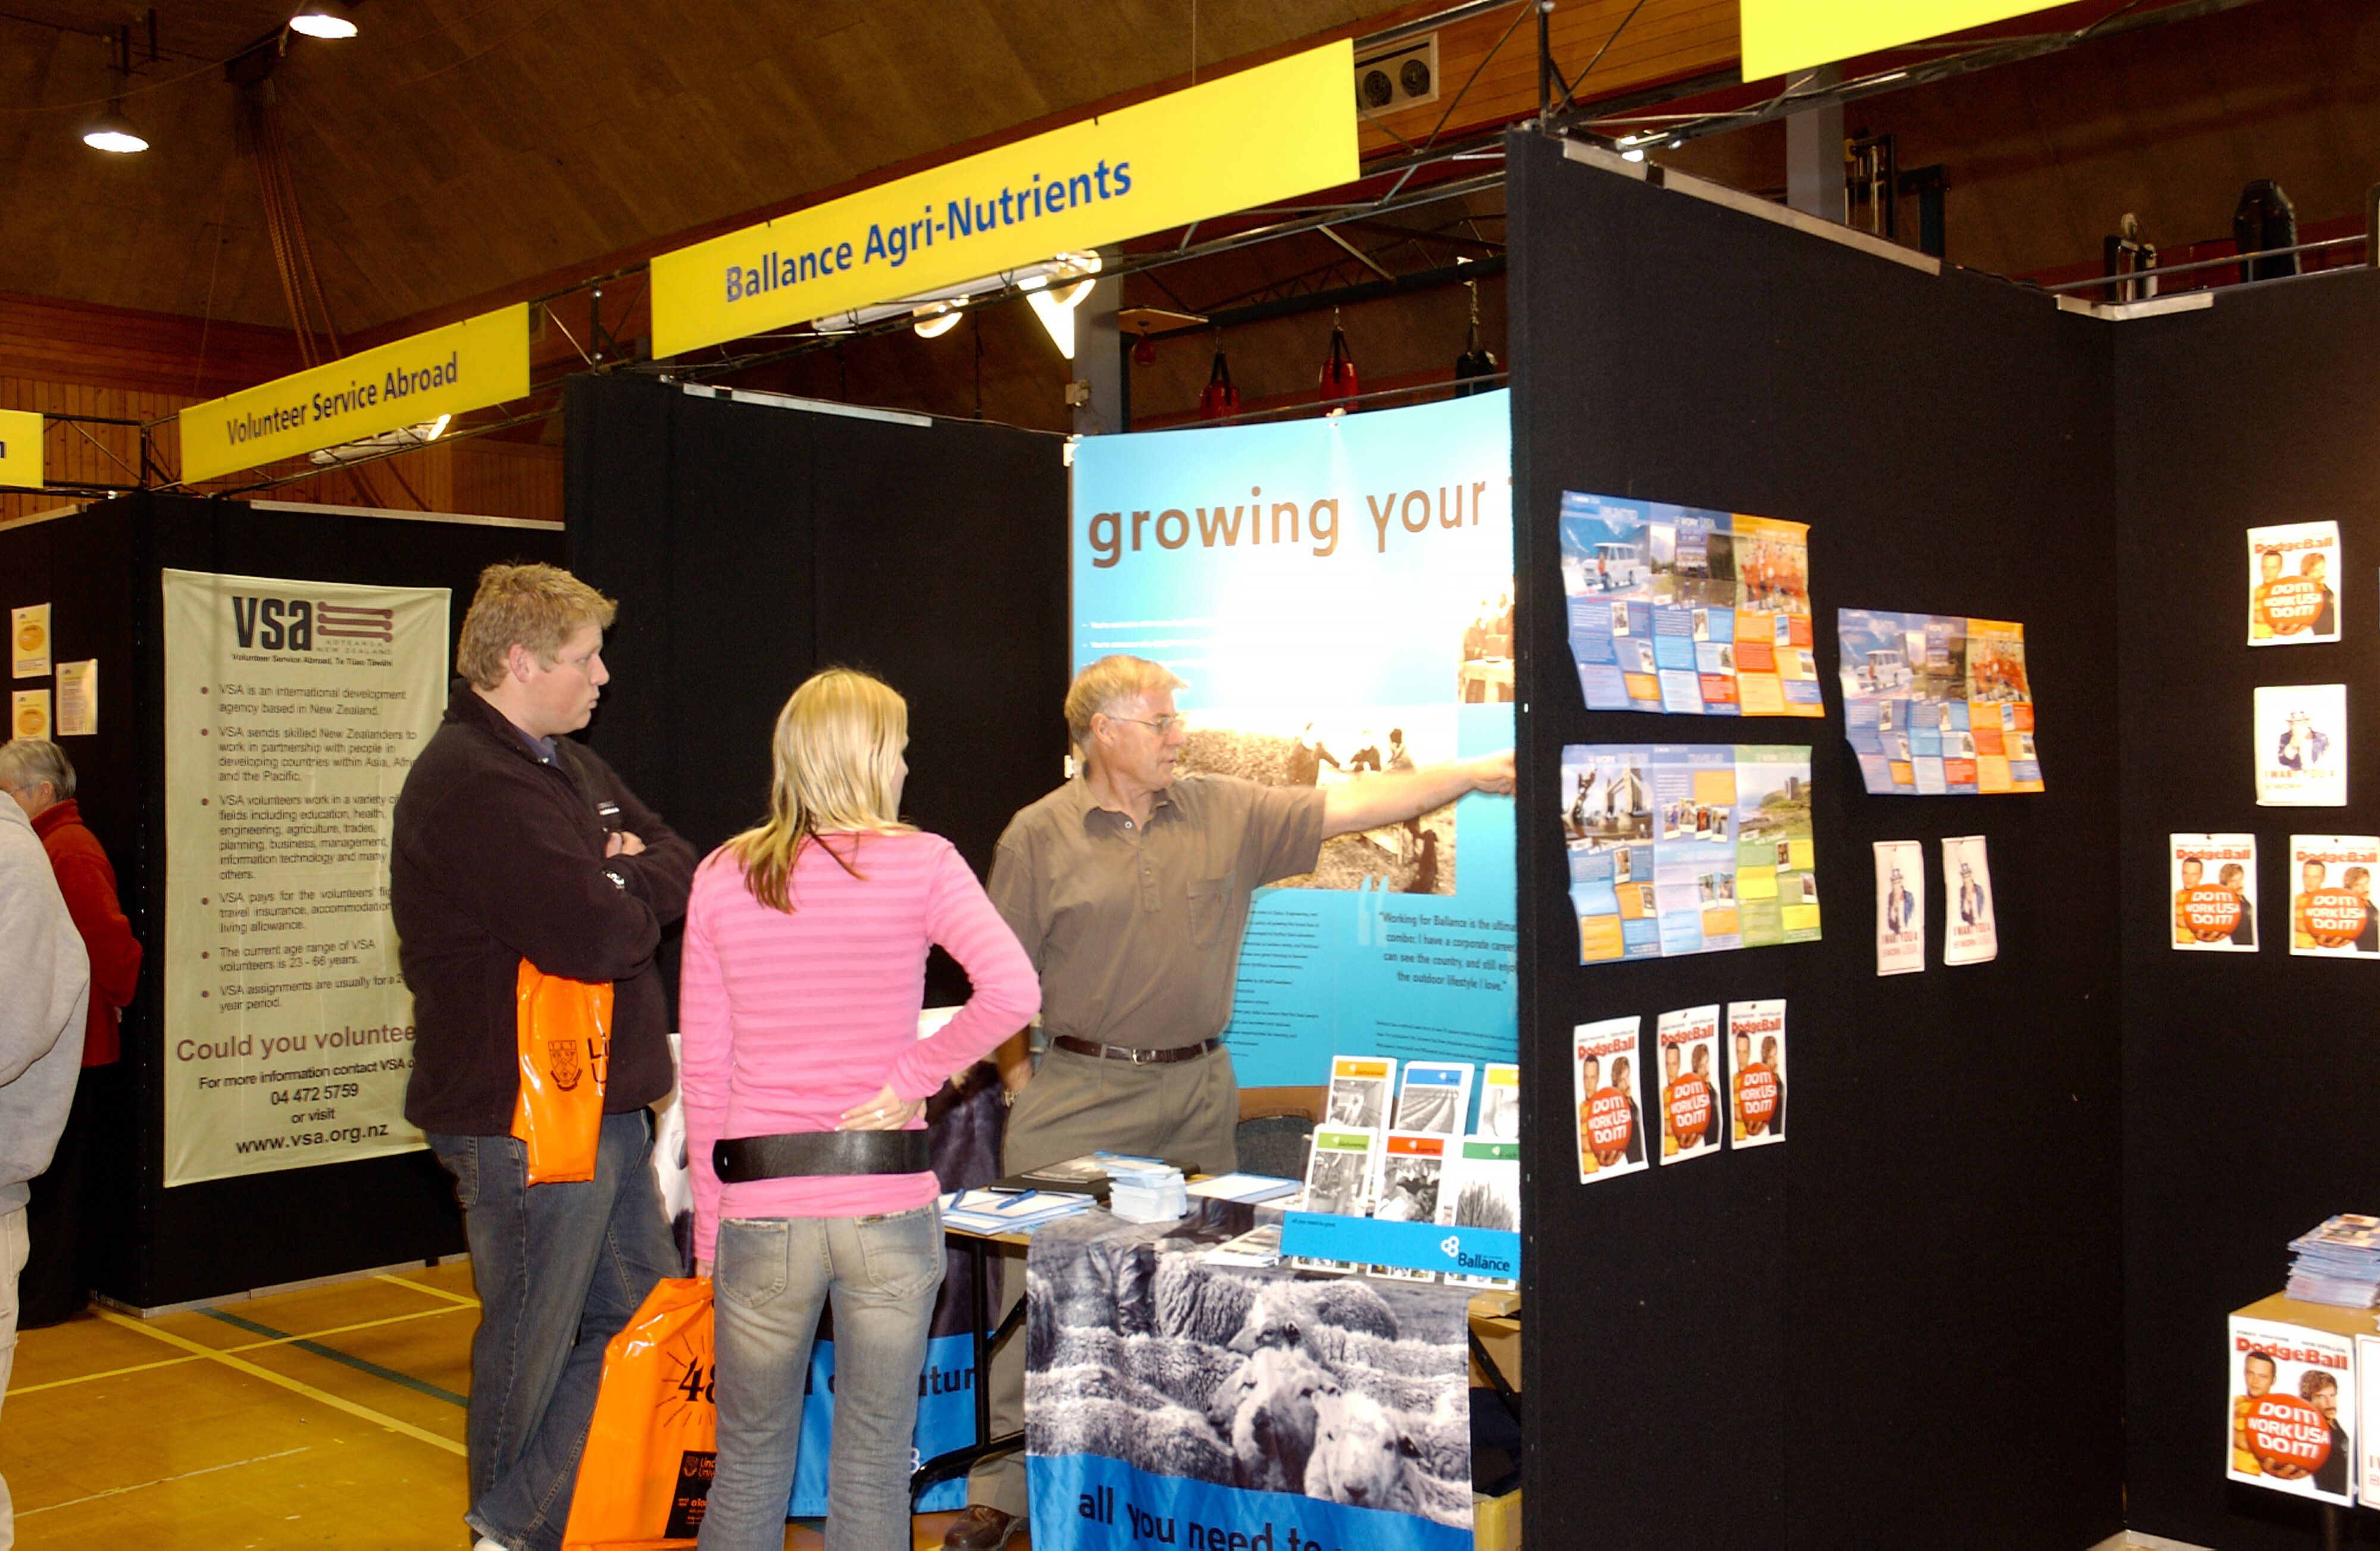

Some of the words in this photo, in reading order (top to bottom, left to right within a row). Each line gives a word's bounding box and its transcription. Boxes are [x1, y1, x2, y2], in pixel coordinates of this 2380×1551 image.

[725, 241, 852, 304] Ballance
[863, 159, 1131, 267] Agri-Nutrients
[227, 403, 307, 444] Volunteer
[312, 381, 377, 421] Service
[384, 351, 458, 401] Abroad
[1089, 485, 1339, 569] growing
[1366, 480, 1486, 554] your
[2255, 537, 2333, 554] DodgeBall
[2176, 849, 2251, 860] DodgeBall
[2296, 851, 2378, 863] DodgeBall
[1493, 920, 1516, 932] ultima
[1499, 963, 1516, 974] enjo
[1660, 1024, 1715, 1046] DodgeBall
[1731, 1018, 1782, 1035] DodgeBall
[177, 1034, 252, 1062] Could
[261, 1034, 308, 1059] you
[314, 1025, 417, 1049] voluntee
[1578, 1036, 1635, 1059] DodgeBall
[199, 1077, 222, 1089] For
[224, 1073, 257, 1087] more
[260, 1067, 330, 1083] information
[333, 1062, 377, 1076] contact
[380, 1058, 406, 1071] VSA
[271, 1091, 289, 1106] 04
[293, 1087, 320, 1103] 472
[324, 1083, 359, 1100] 5759
[291, 1112, 306, 1124] or
[309, 1108, 336, 1121] visit
[236, 1123, 389, 1155] www.vsa.org.nz
[1458, 1253, 1510, 1272] Ballance
[2235, 1336, 2348, 1370] DodgeBall
[2259, 1402, 2291, 1419] DO
[2293, 1408, 2318, 1425] IT!
[2248, 1416, 2293, 1437] WORK
[2294, 1427, 2329, 1444] USA
[2258, 1434, 2290, 1453] DO
[2291, 1439, 2319, 1458] IT!
[701, 1458, 715, 1468] Linc
[1079, 1485, 1113, 1524] all
[1127, 1502, 1175, 1543] you
[1189, 1522, 1274, 1551] need
